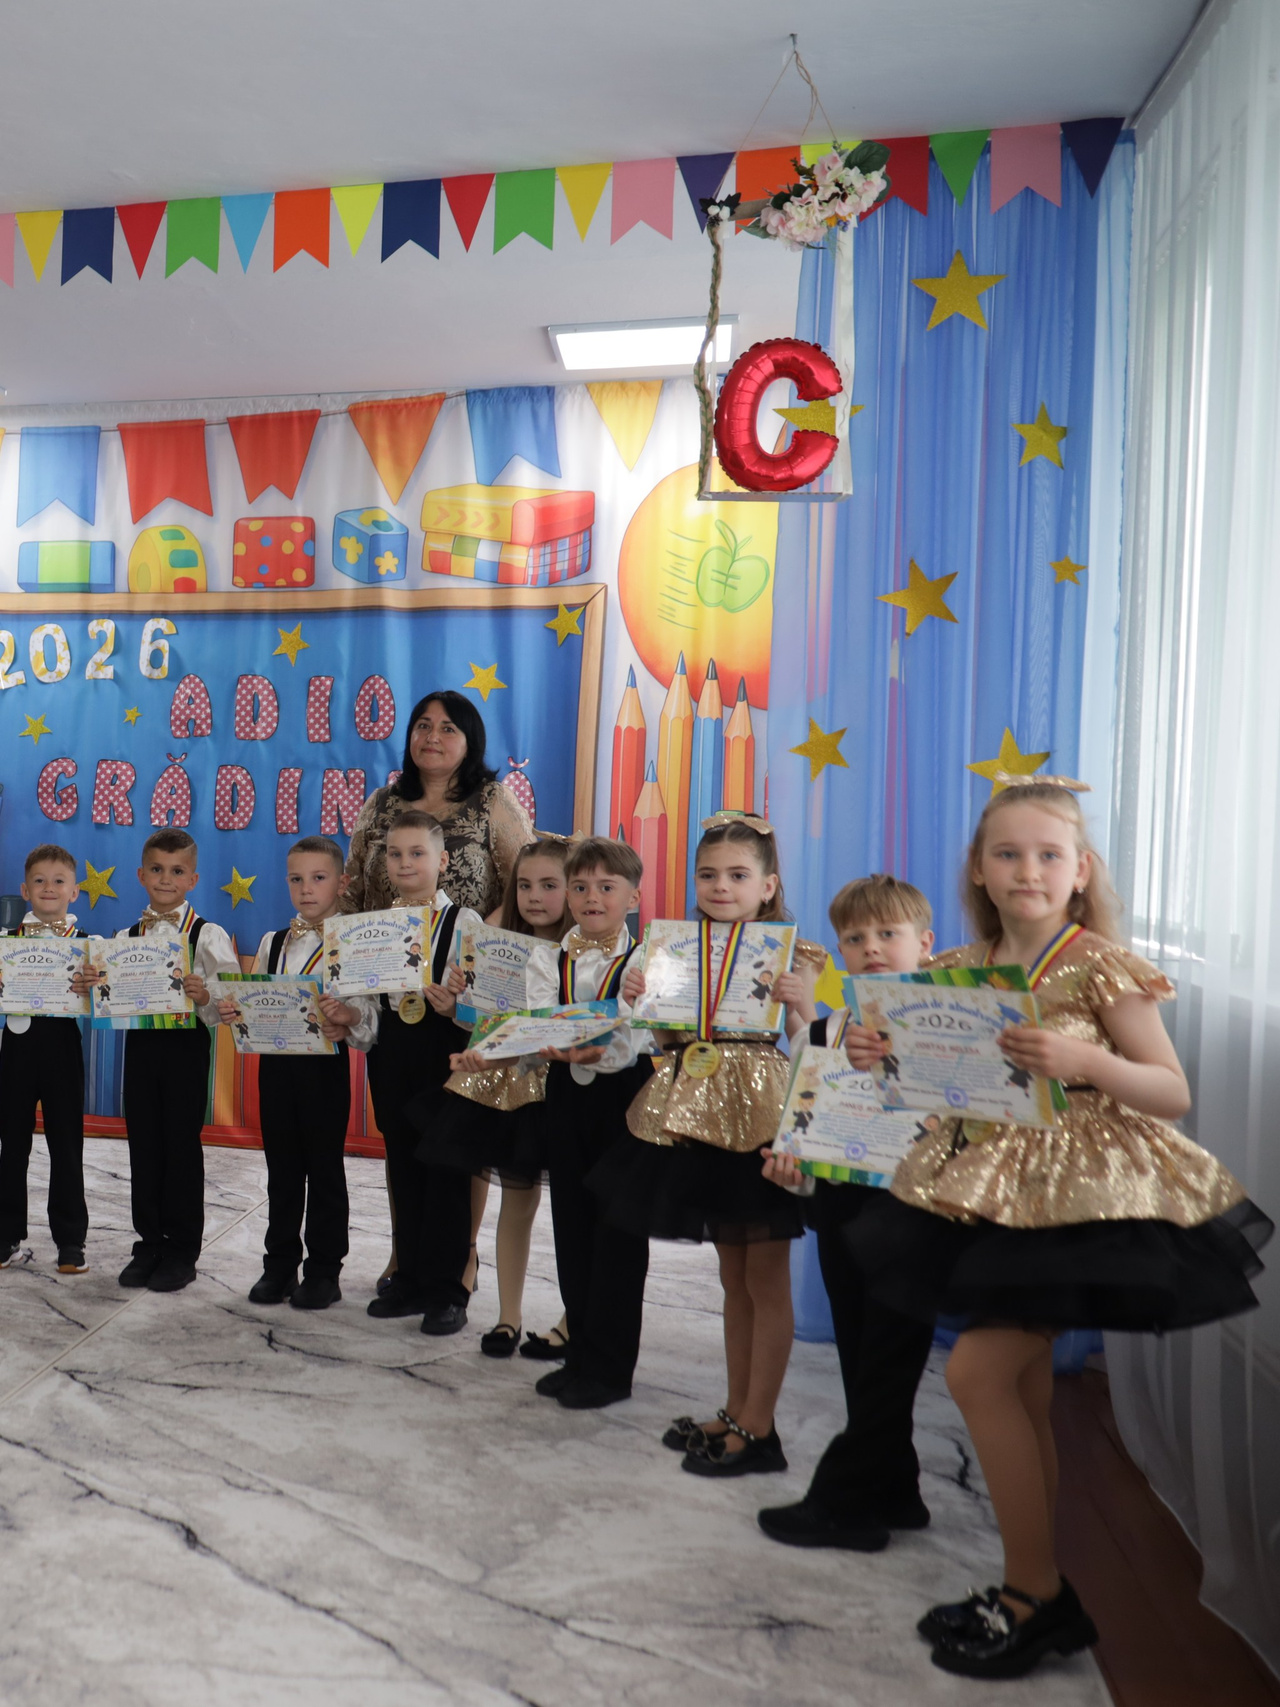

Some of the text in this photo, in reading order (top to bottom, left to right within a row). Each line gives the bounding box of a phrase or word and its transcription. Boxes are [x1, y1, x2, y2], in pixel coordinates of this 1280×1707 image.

[714, 337, 843, 492] C
[169, 673, 396, 743] ADIO
[36, 752, 537, 836] GRĂDINĂ
[356, 929, 390, 940] 2026
[20, 955, 54, 964] 2026
[122, 954, 153, 964] 2026
[490, 948, 522, 962] 2026
[254, 998, 286, 1006] 2026
[916, 1013, 972, 1032] 2026
[847, 1079, 873, 1092] 20
